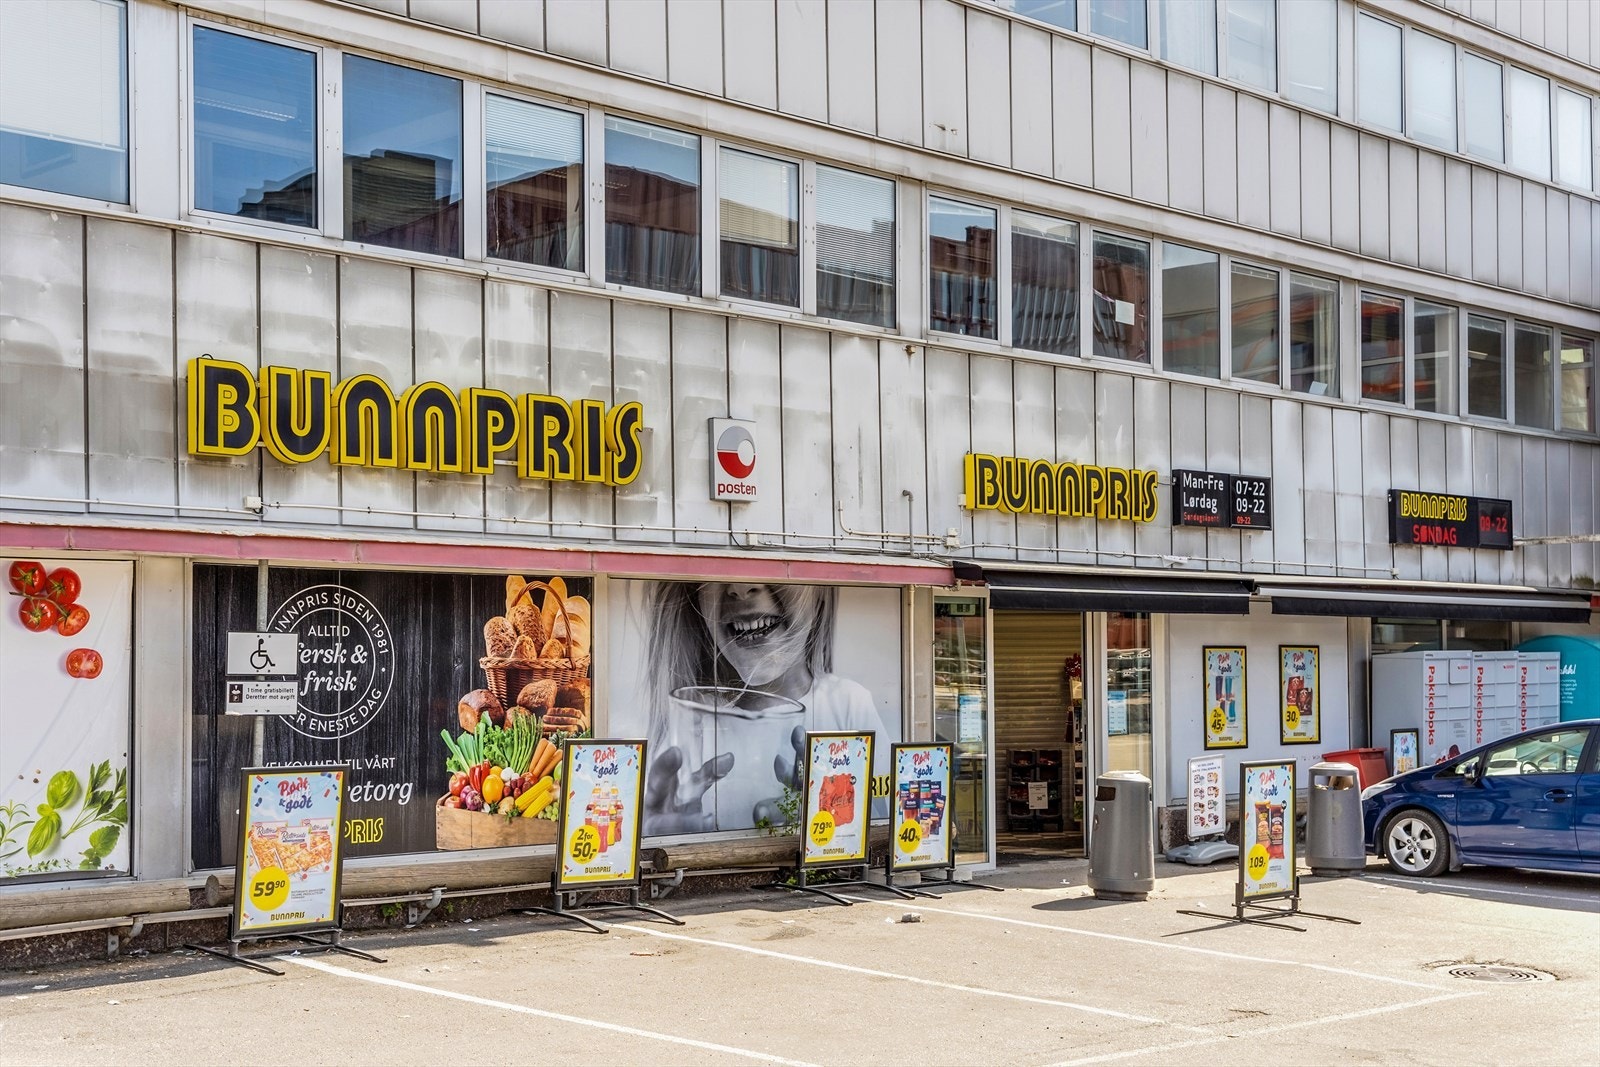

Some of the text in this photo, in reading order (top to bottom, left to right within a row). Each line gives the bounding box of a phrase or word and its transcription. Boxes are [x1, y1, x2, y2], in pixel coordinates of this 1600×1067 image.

[188, 357, 643, 486] BUNNPRIS
[717, 481, 757, 496] posten
[965, 453, 1158, 523] BUNNPRIS
[1183, 472, 1224, 491] Man-Fre
[1236, 480, 1265, 496] 07-22
[1183, 492, 1217, 514] Lørdag
[1236, 498, 1265, 513] 09-22
[1401, 492, 1467, 521] BUNNPRIS
[1236, 516, 1251, 525] 09-22
[1413, 524, 1457, 545] SØNDAG
[307, 625, 350, 637] ALLTID
[333, 592, 374, 624] SIDEN
[371, 623, 389, 655] 1981
[350, 644, 368, 664] &
[299, 670, 358, 697] frisk
[309, 711, 359, 733] ENESTE
[358, 687, 382, 718] DAG
[1427, 665, 1436, 746] Pakkeboks
[365, 754, 395, 769] VÅRT
[832, 754, 850, 769] godt
[598, 763, 619, 779] godt
[917, 764, 933, 778] godt
[277, 776, 308, 797] Rødt
[347, 780, 413, 805] etorg
[285, 795, 313, 813] godt
[573, 842, 597, 859] 50,-
[585, 866, 611, 874] BUNNPRIS
[270, 912, 305, 921] BUNNPRIS
